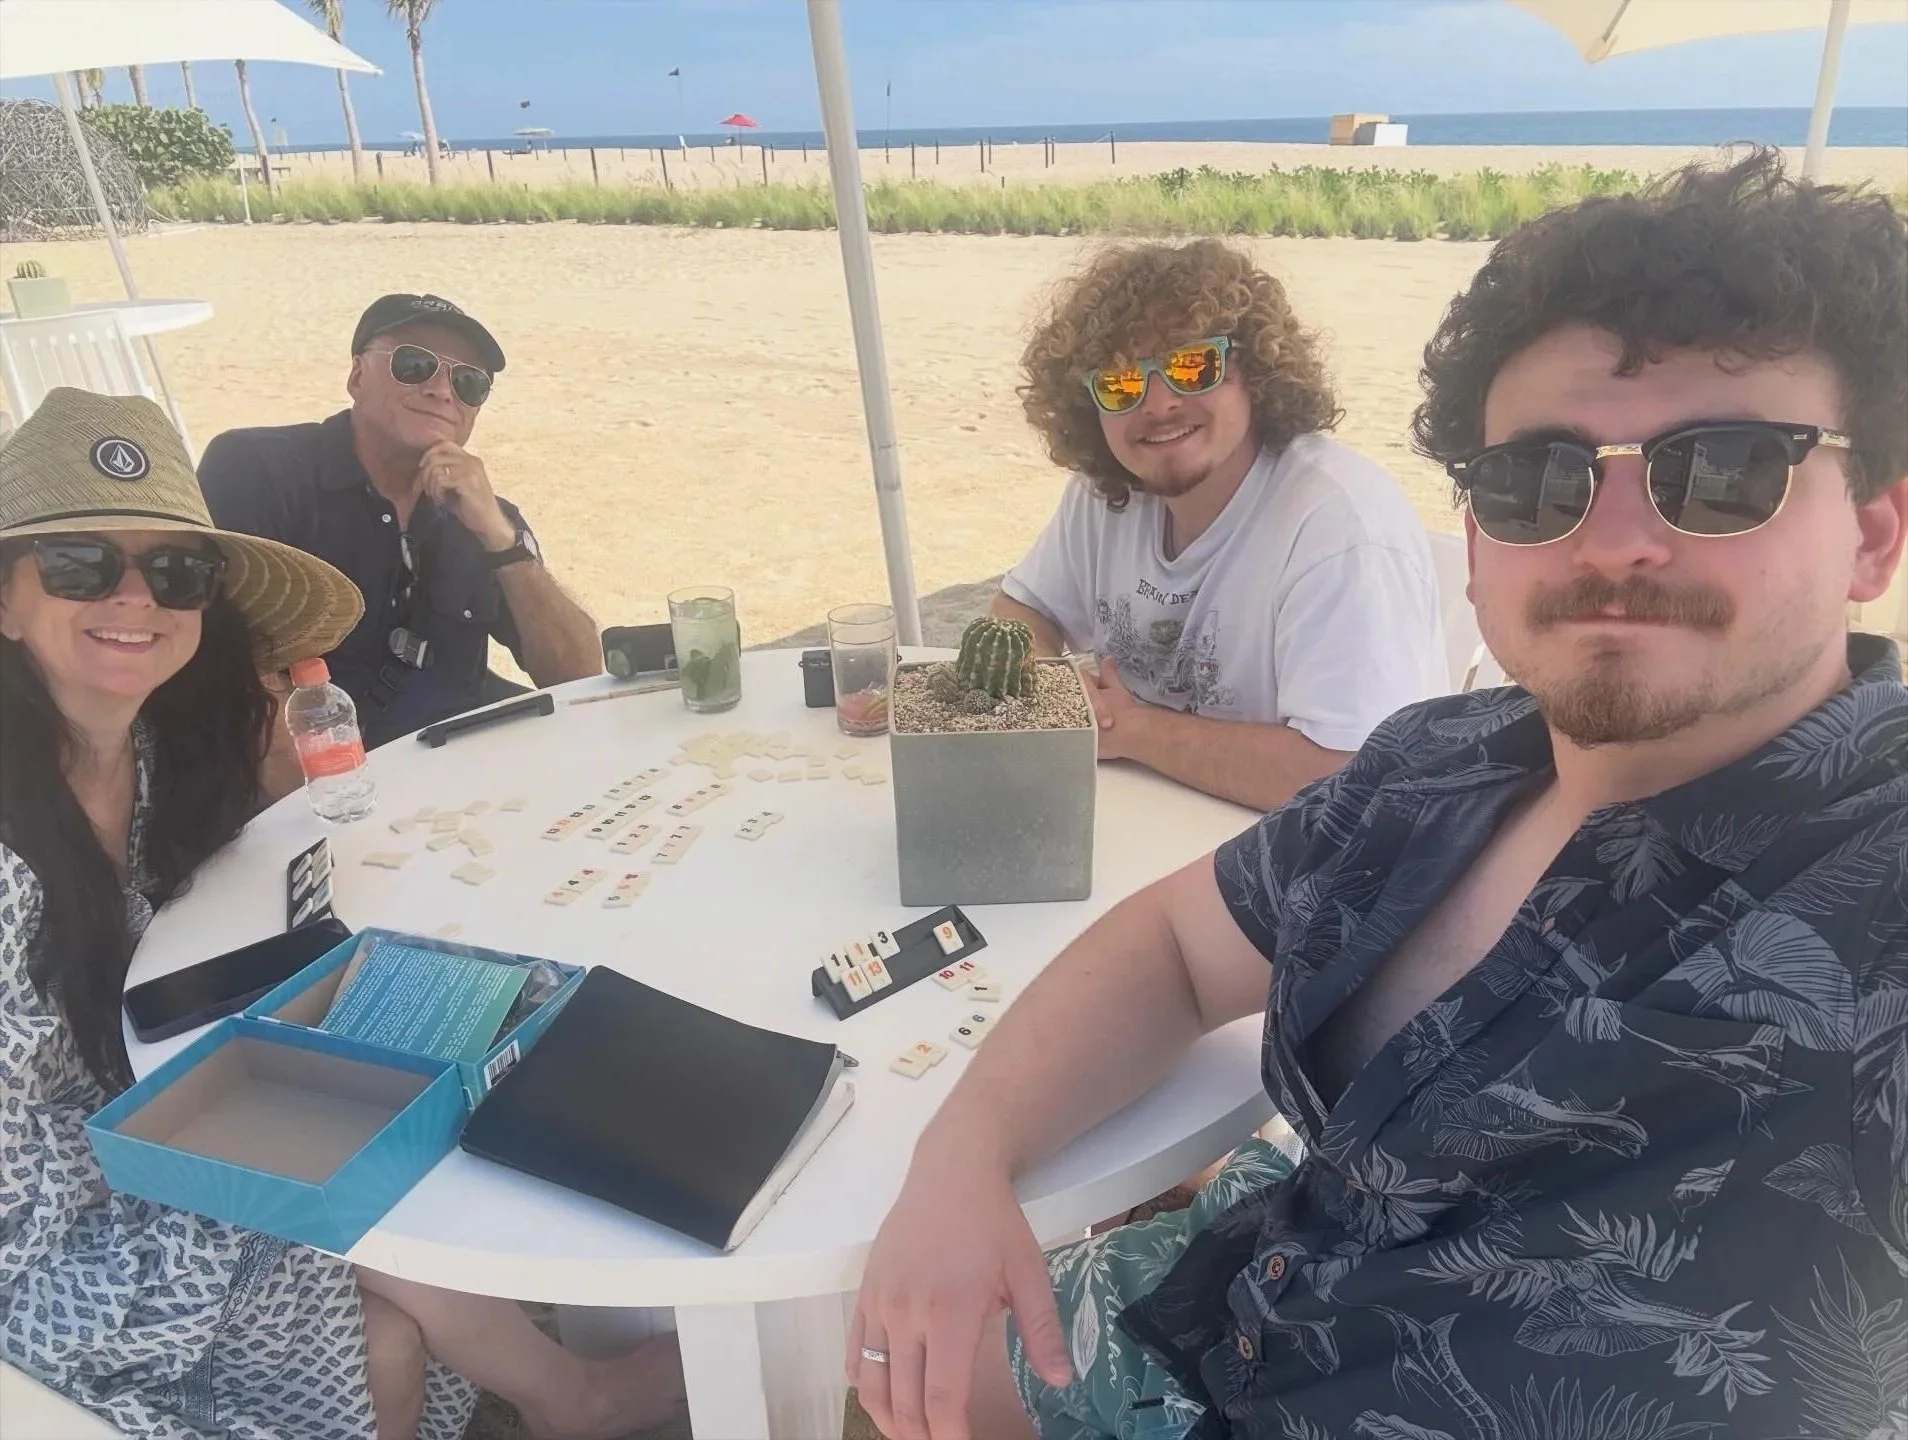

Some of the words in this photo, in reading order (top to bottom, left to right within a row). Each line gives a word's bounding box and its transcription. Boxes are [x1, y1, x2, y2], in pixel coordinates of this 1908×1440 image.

[1136, 578, 1169, 606] BRAIN
[830, 953, 841, 967] 1
[877, 930, 889, 944] 3
[941, 925, 953, 939] 9
[847, 970, 863, 986] 11
[938, 970, 955, 979] 10
[959, 961, 975, 971] 11
[958, 1027, 972, 1036] 6
[972, 1014, 986, 1023] 6
[915, 1043, 932, 1054] 2
